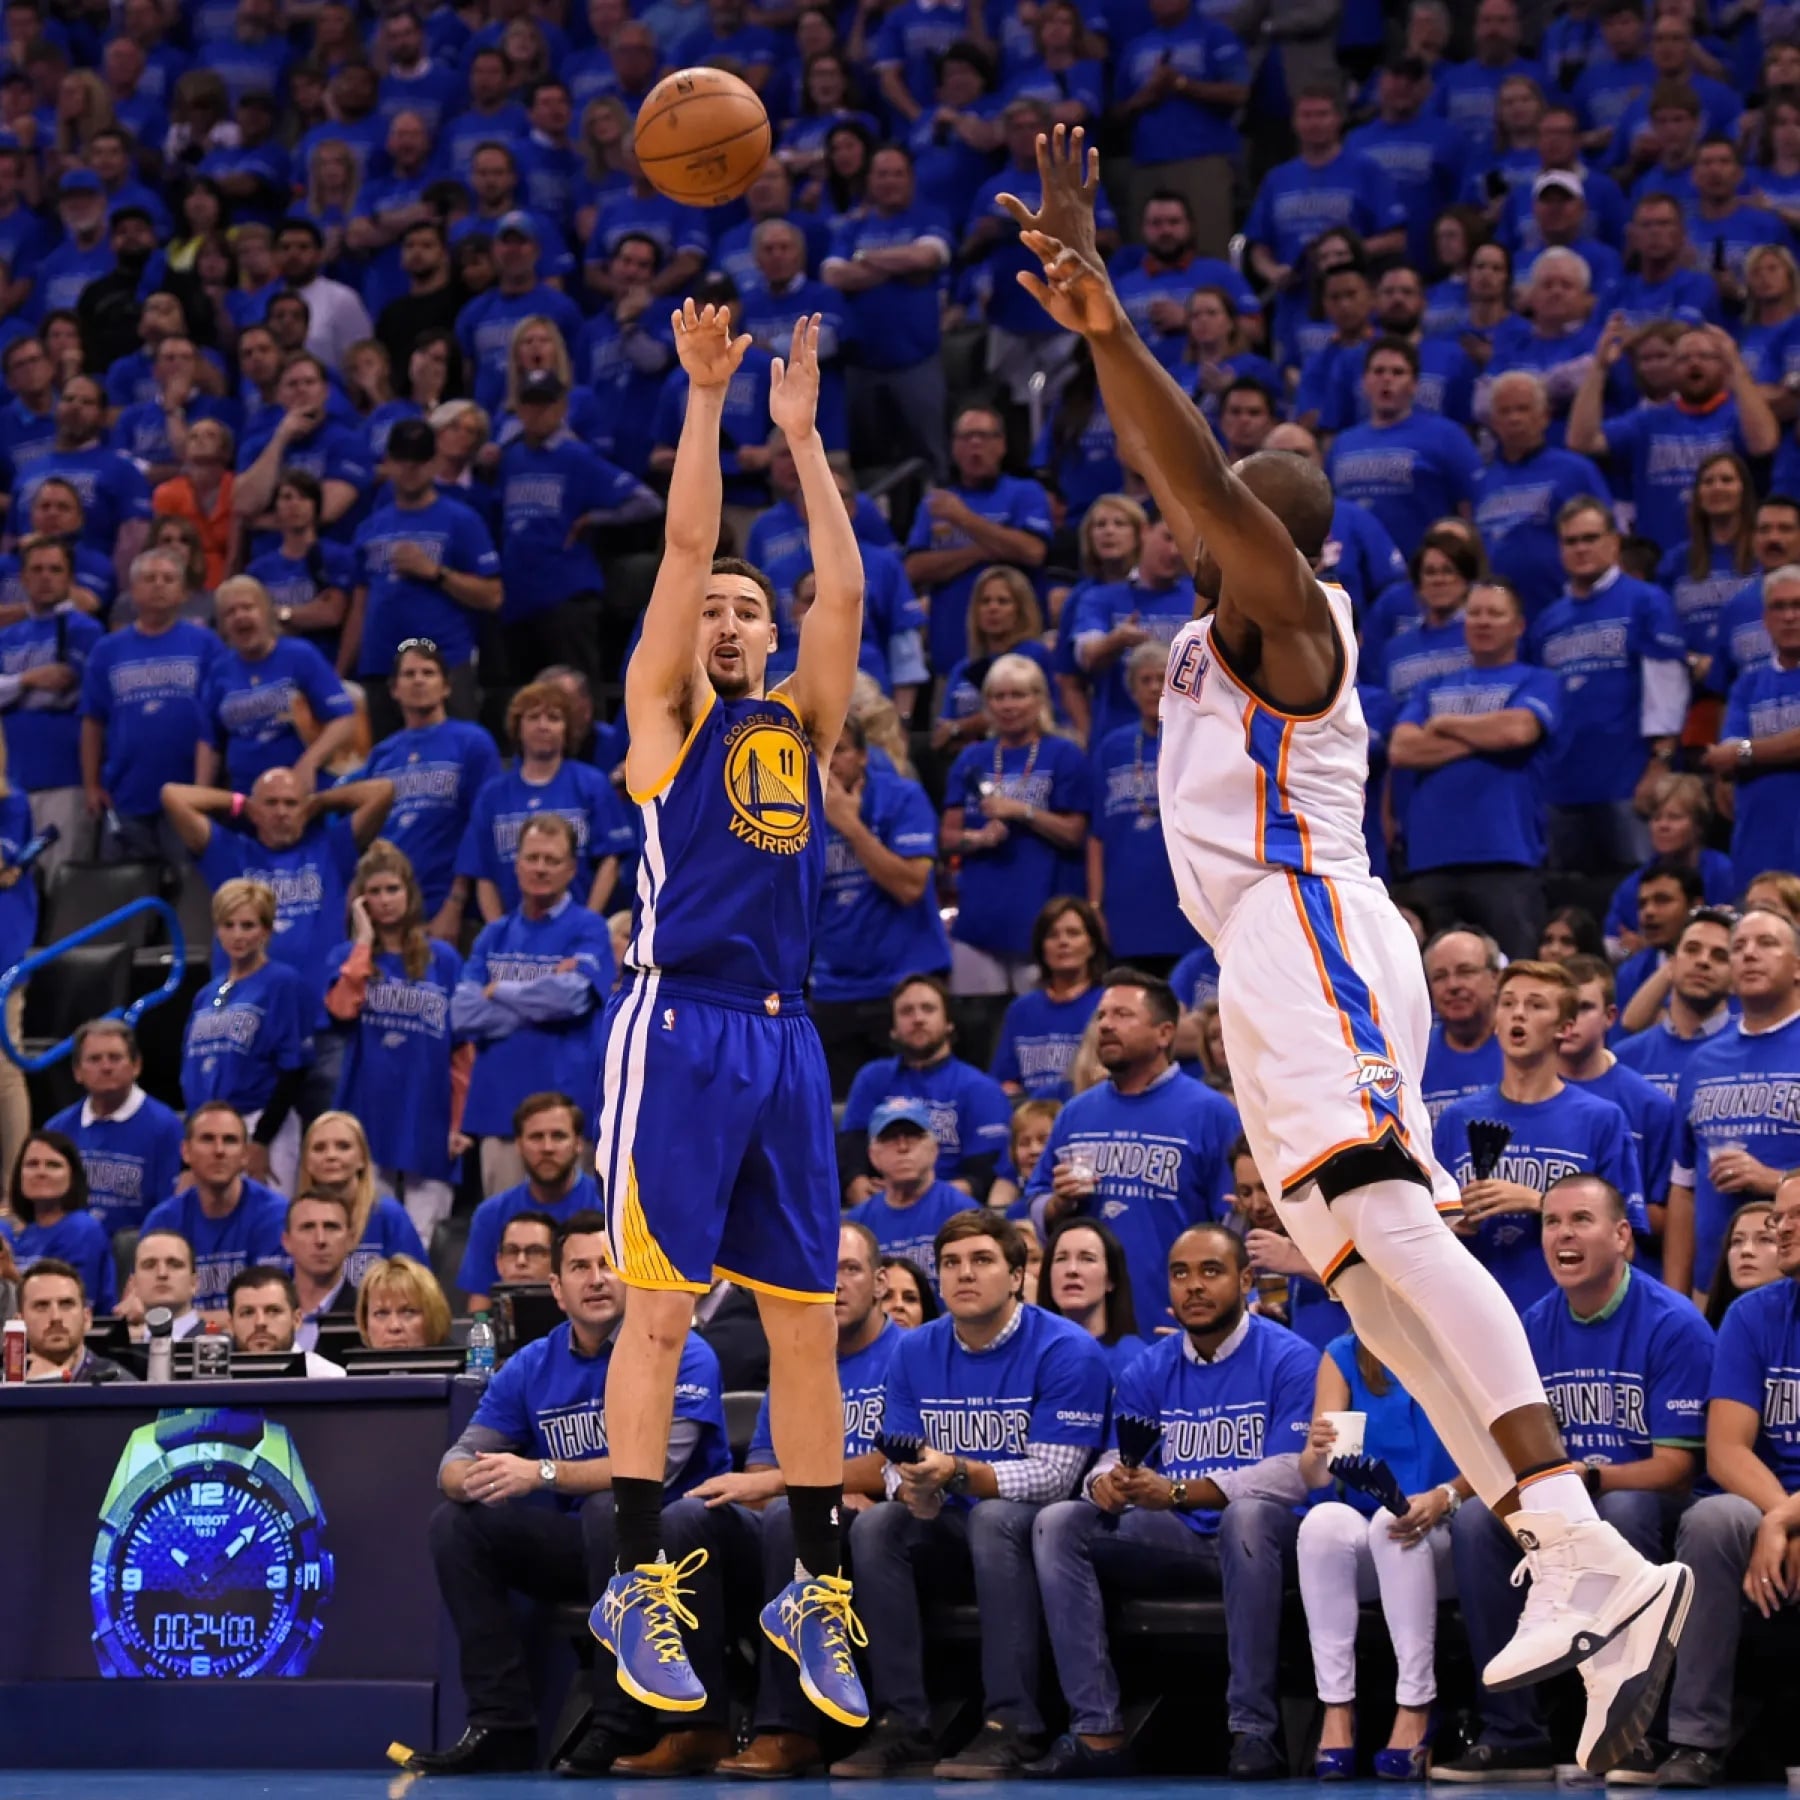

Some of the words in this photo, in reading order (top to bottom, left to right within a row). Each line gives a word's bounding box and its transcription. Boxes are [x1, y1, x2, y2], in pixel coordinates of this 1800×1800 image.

[723, 714, 774, 746] GOLDEN
[779, 748, 794, 776] 11
[1357, 1065, 1394, 1085] OKC
[1691, 1081, 1800, 1125] THUNDER
[539, 1408, 609, 1460] THUN
[920, 1409, 1031, 1454] THUNDER
[190, 1482, 225, 1507] 12
[182, 1514, 230, 1526] TISSOT
[121, 1568, 143, 1592] 9
[266, 1565, 288, 1590] 3
[190, 1655, 211, 1676] 6
